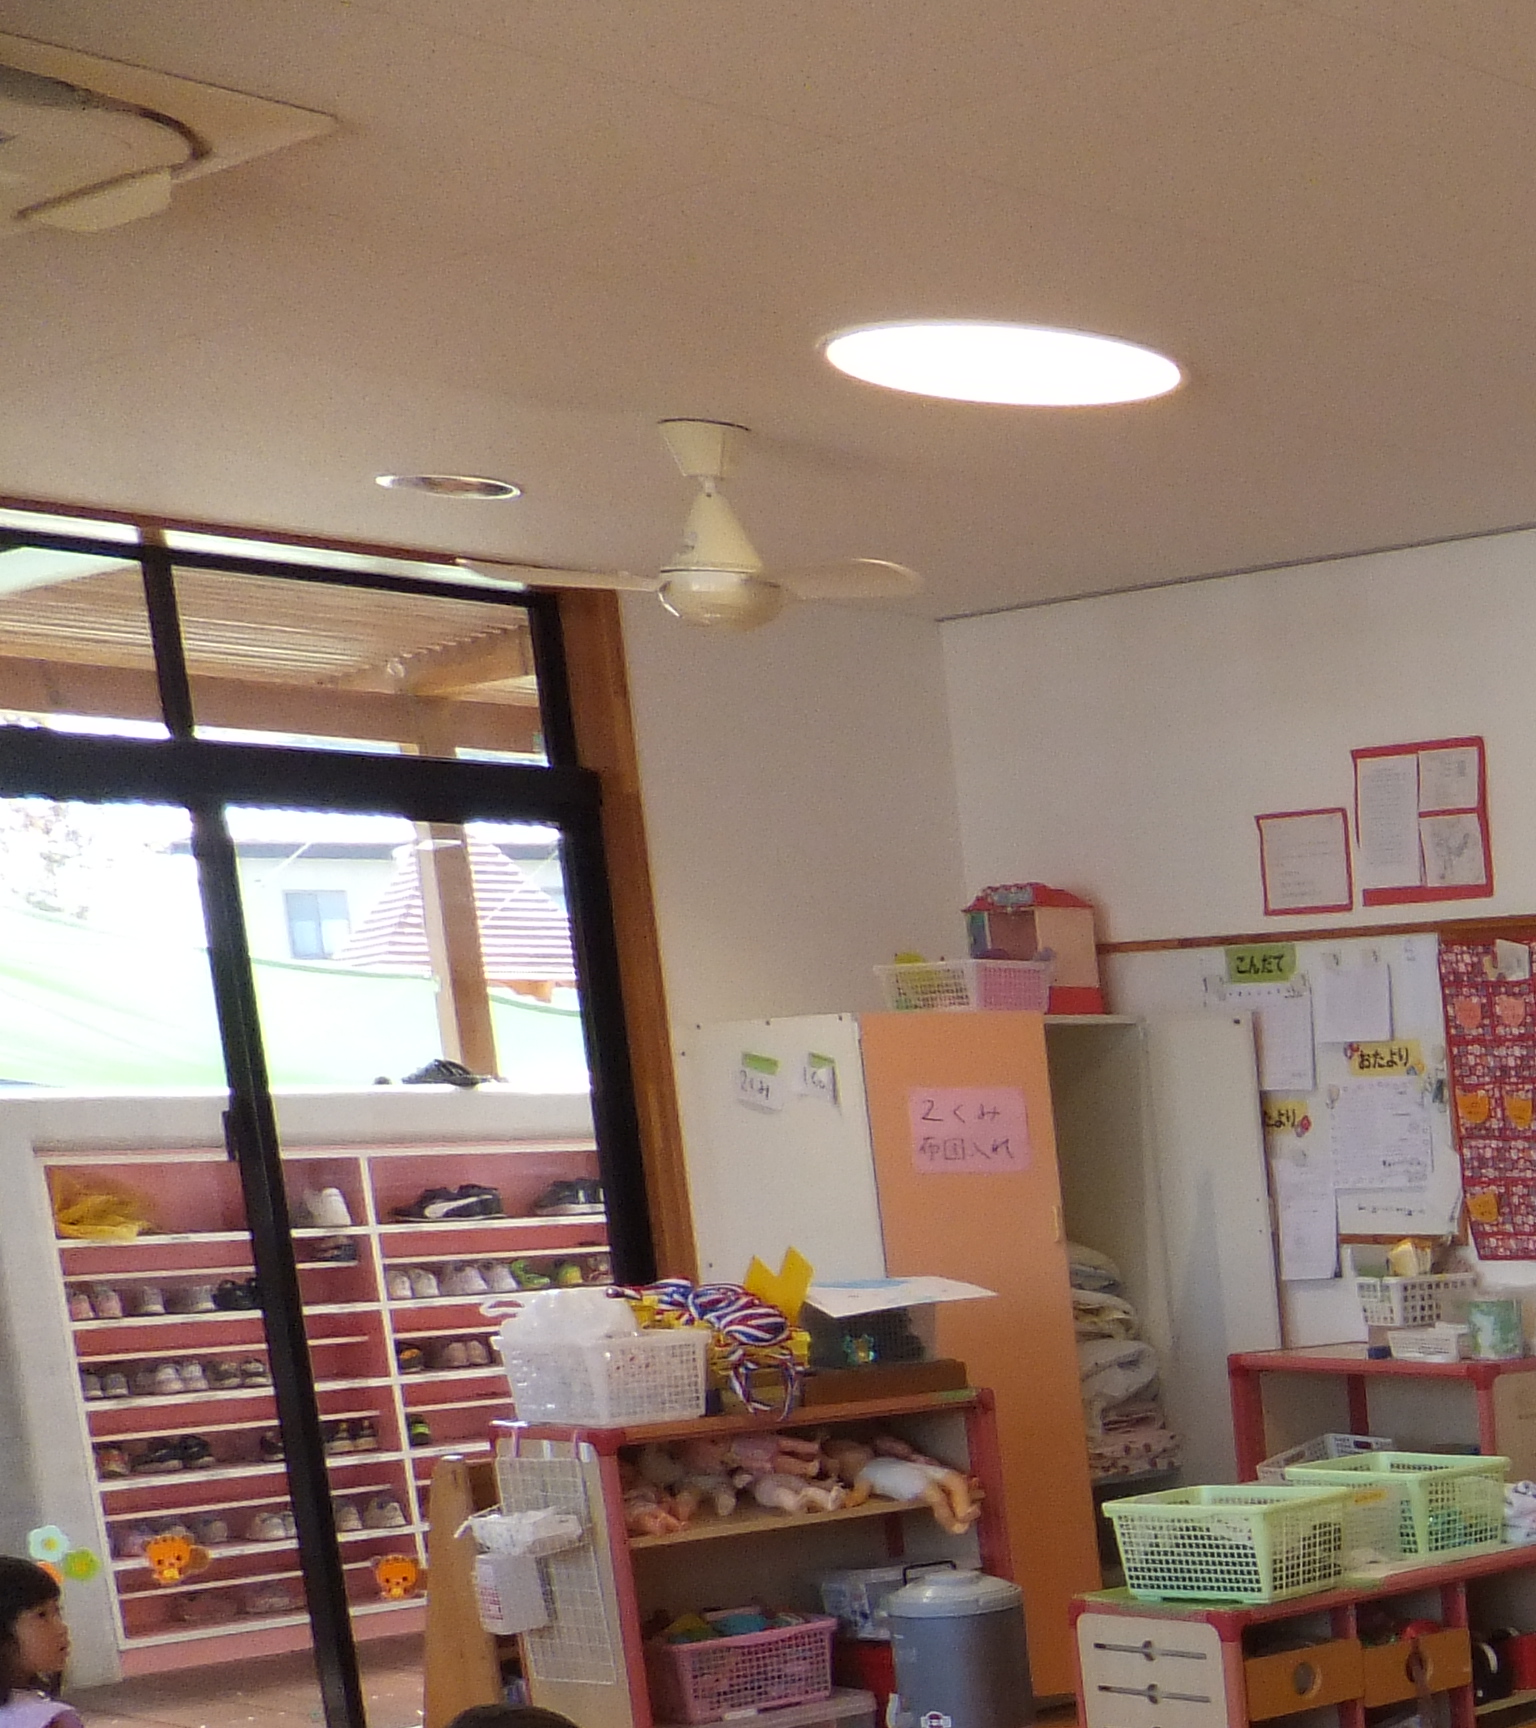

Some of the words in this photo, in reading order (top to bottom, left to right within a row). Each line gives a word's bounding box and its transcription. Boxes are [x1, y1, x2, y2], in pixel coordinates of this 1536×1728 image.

[1236, 954, 1284, 974] こんだて
[1359, 1047, 1408, 1070] おたより
[920, 1099, 1001, 1124] 2くみ
